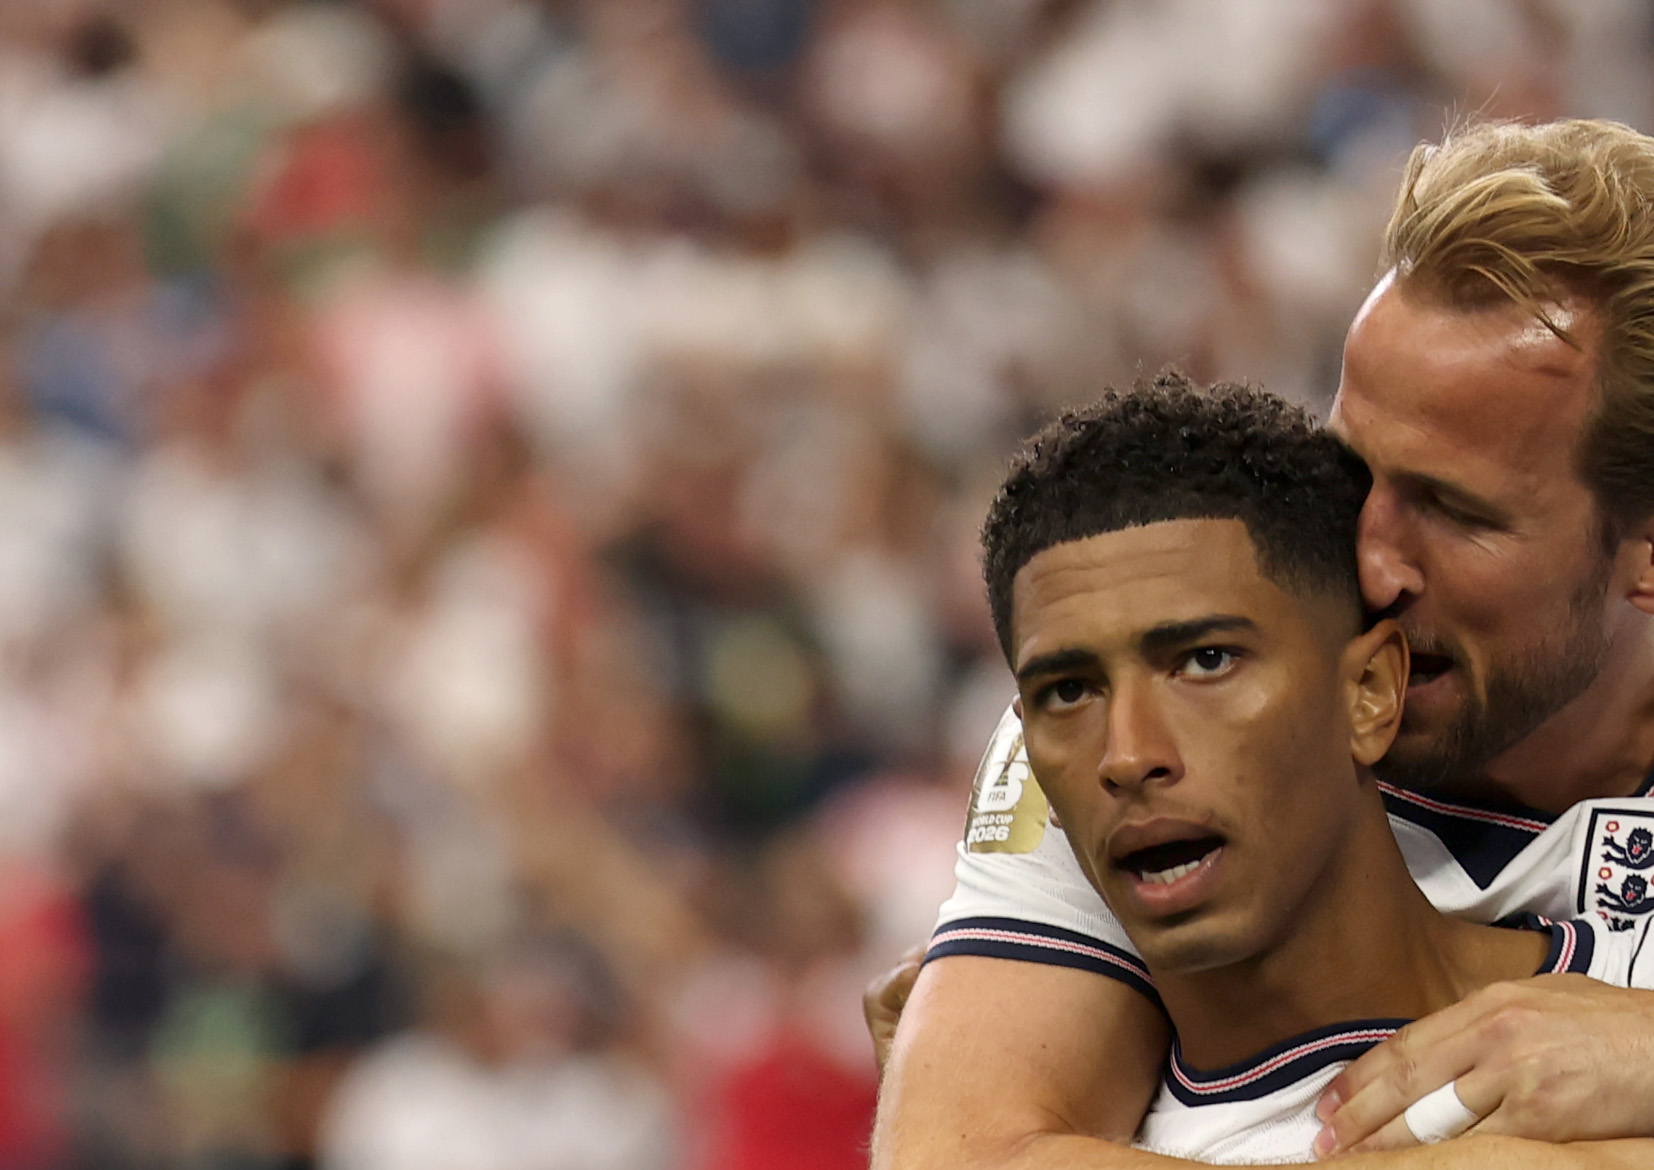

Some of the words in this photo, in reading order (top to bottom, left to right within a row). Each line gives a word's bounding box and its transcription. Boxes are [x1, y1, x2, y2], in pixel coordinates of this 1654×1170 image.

[987, 790, 1006, 803] FIFA
[972, 814, 996, 828] WORLD
[995, 814, 1014, 825] CUP
[968, 825, 1010, 844] 2026
